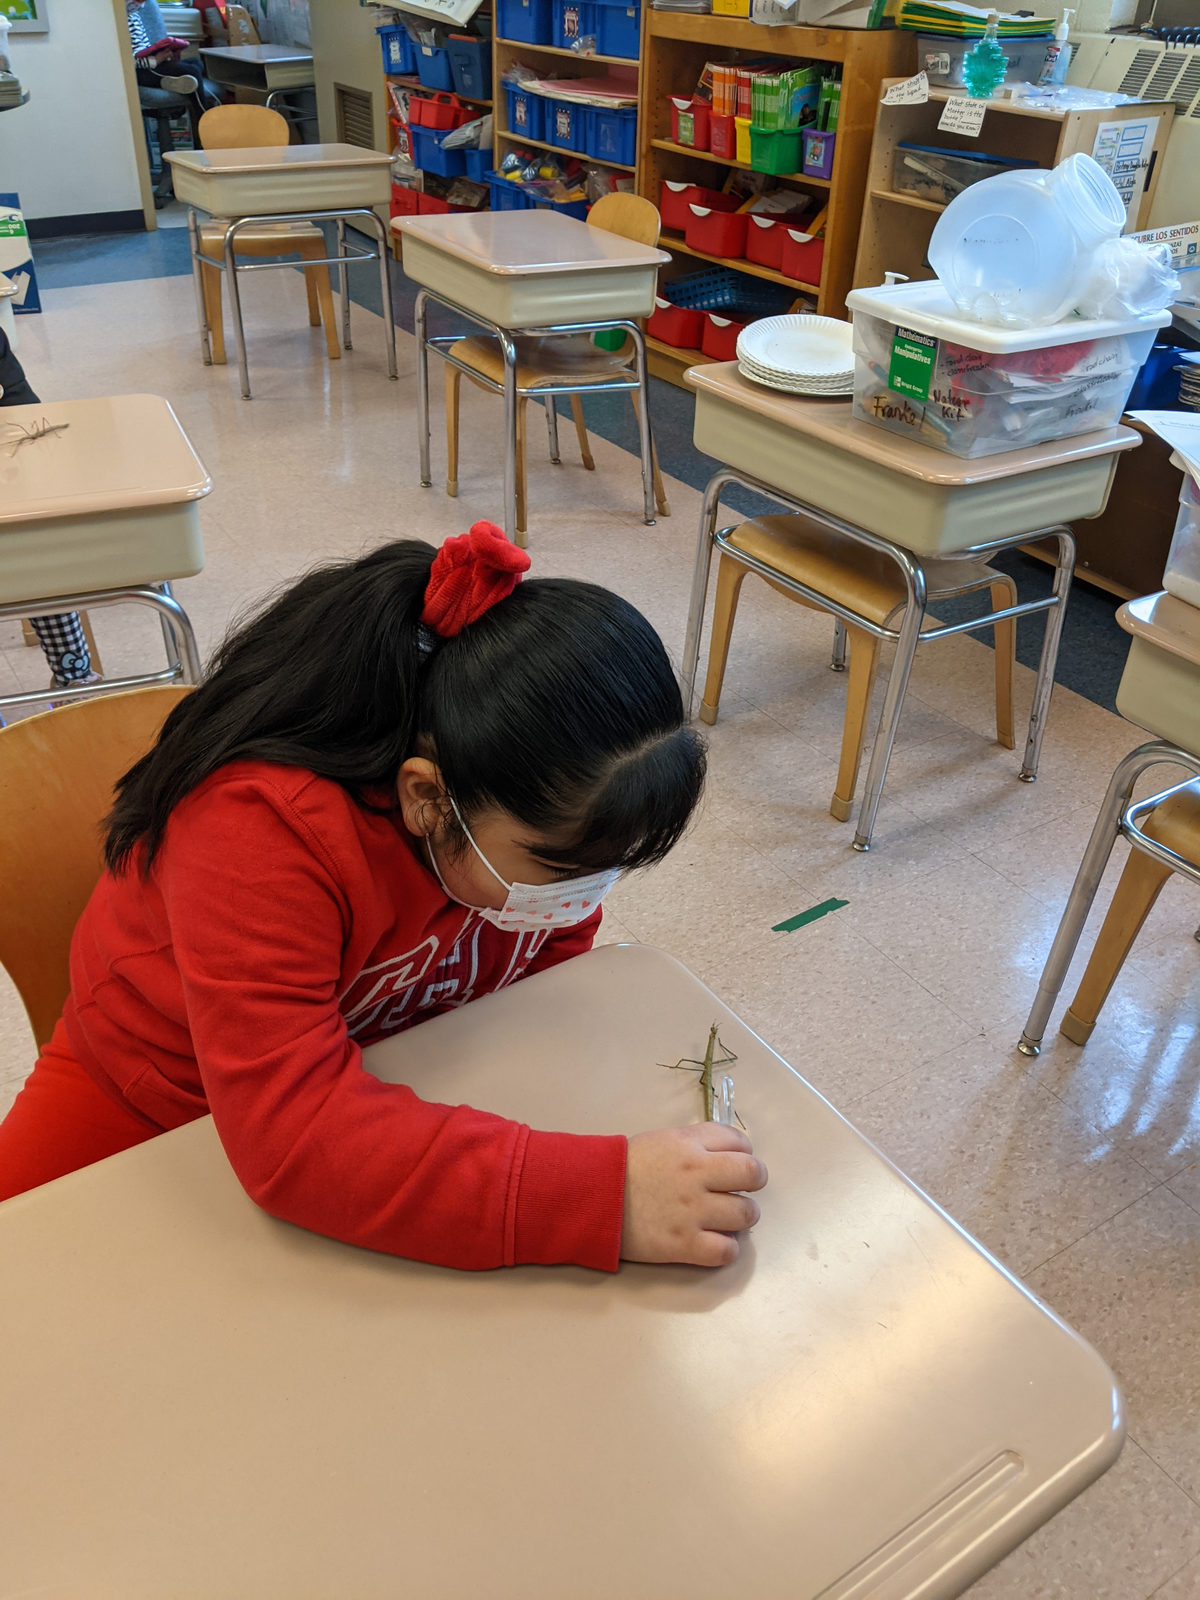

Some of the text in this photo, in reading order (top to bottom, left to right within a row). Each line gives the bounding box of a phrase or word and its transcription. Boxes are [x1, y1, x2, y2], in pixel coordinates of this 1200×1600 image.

[948, 98, 964, 107] What
[1155, 230, 1168, 241] LOS
[1169, 224, 1199, 239] SENTIDOS
[897, 327, 935, 348] Mathematics
[894, 345, 932, 365] Manipulatives
[941, 406, 964, 421] Kit
